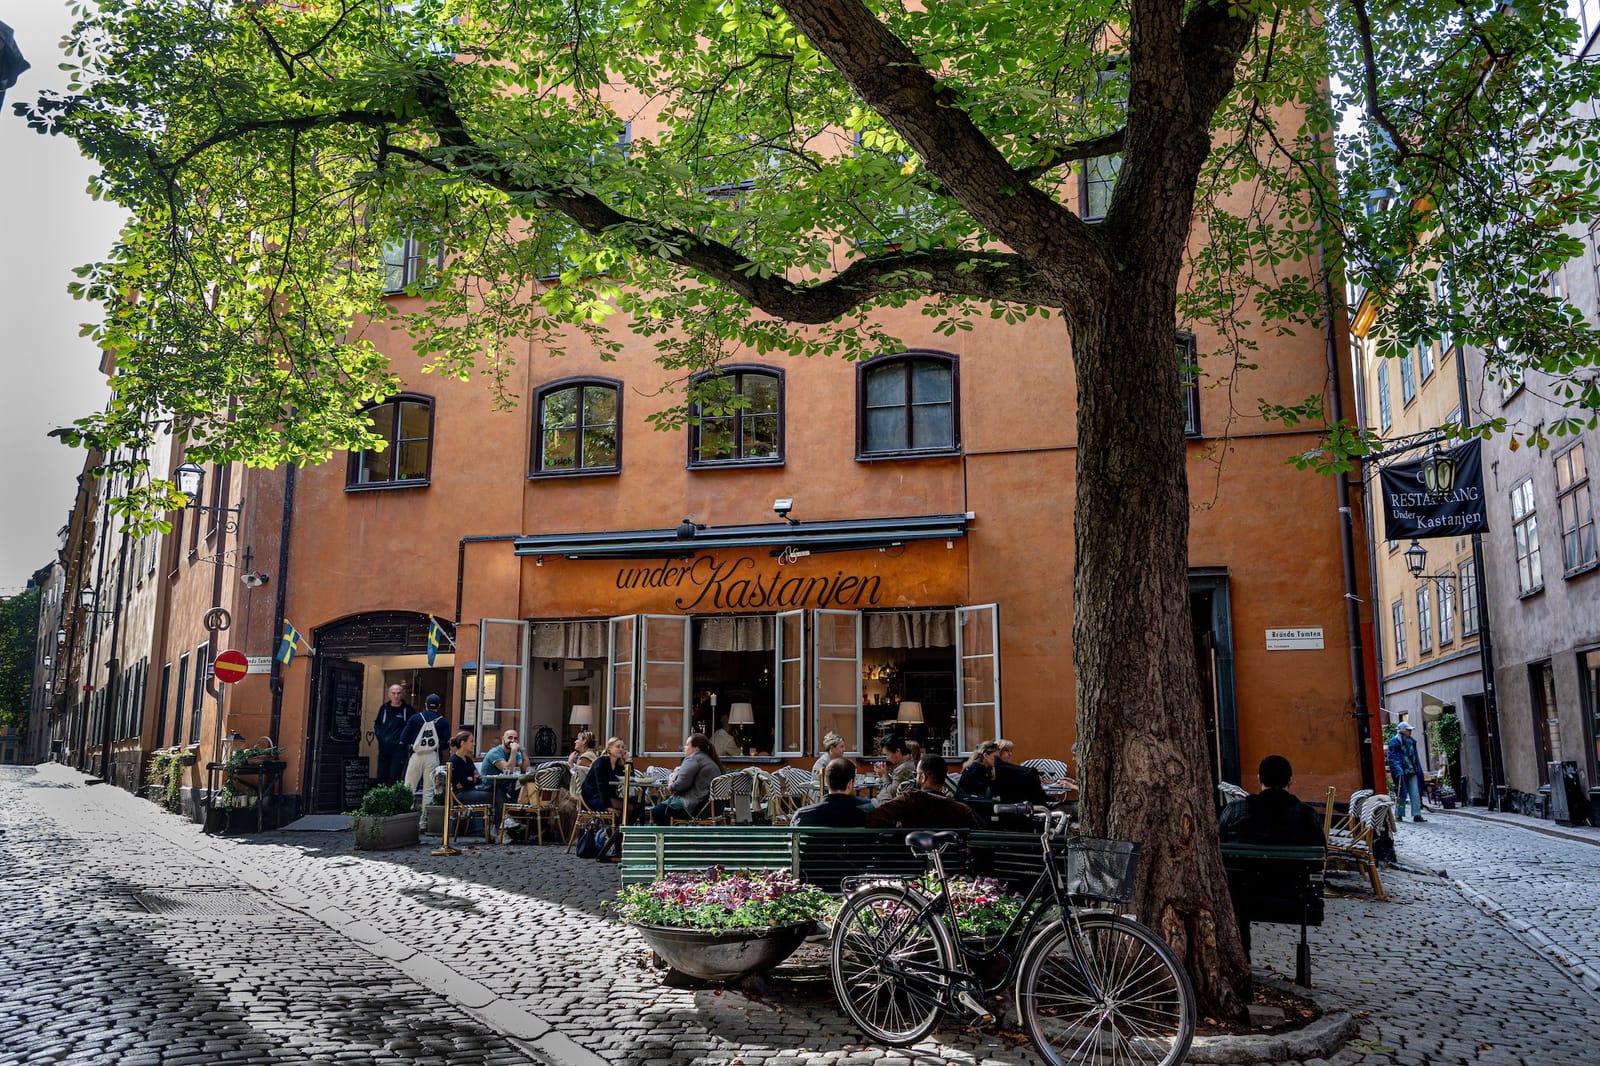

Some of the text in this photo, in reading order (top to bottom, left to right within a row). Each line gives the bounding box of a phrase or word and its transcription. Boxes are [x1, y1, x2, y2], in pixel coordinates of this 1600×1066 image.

[1391, 487, 1478, 507] RESTAANG
[1393, 509, 1481, 529] Under Kastanjen
[616, 555, 882, 610] under Kastanjen
